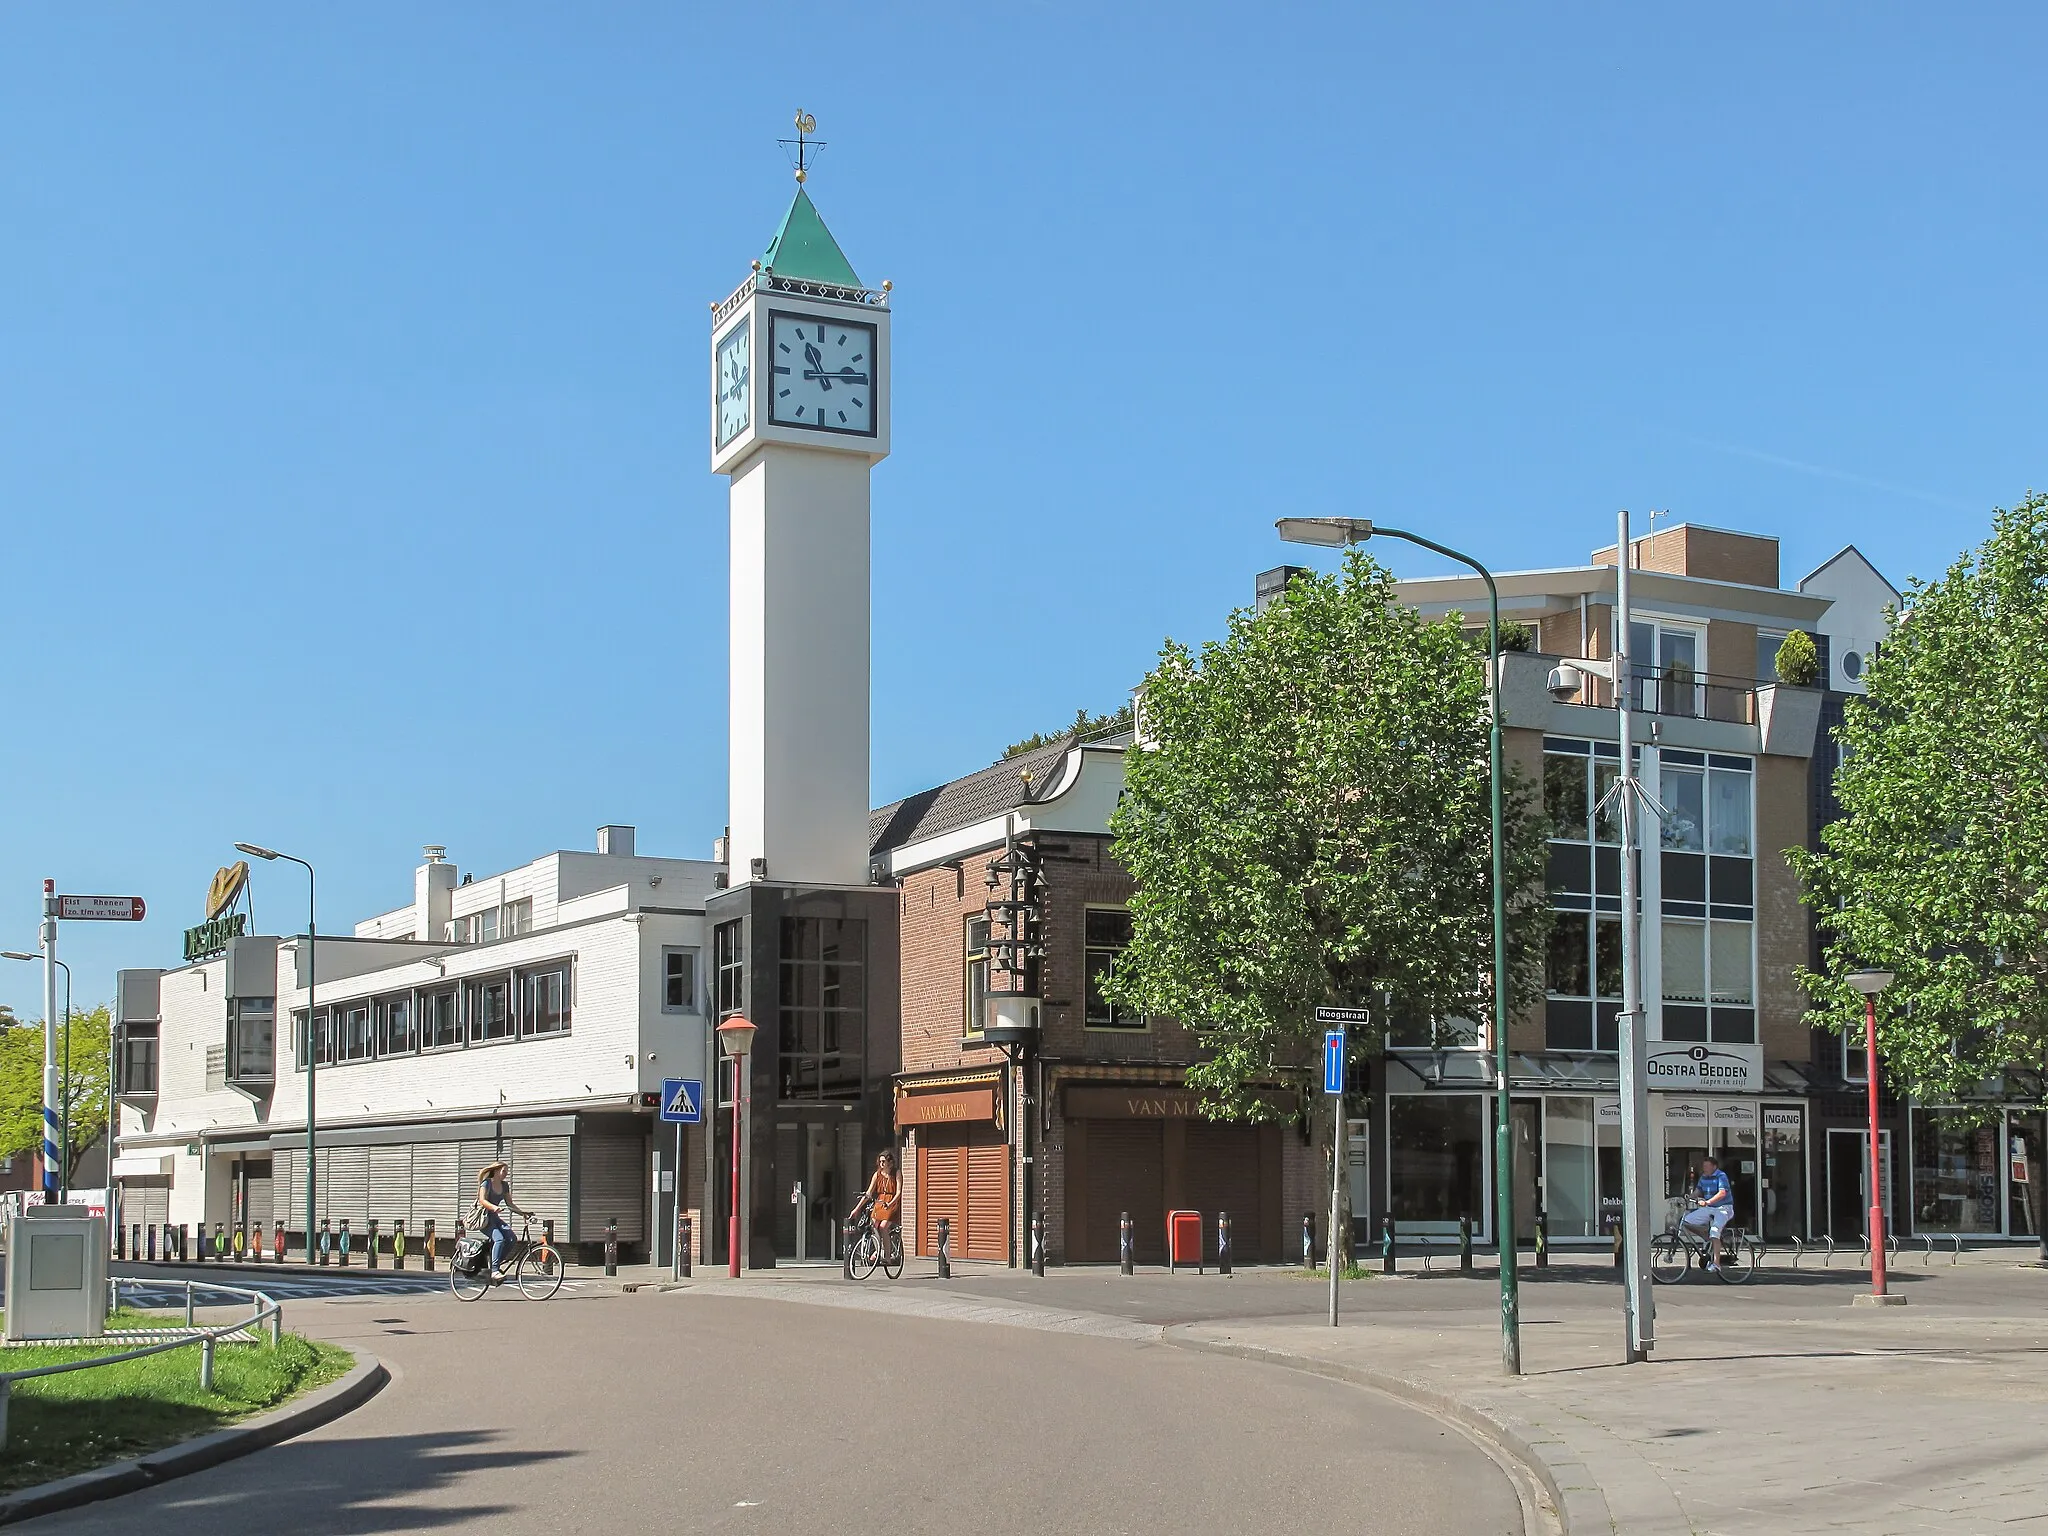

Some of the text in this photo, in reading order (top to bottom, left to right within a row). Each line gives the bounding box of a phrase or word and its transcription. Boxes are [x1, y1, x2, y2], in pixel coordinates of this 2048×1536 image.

[64, 897, 124, 907] Elst Rhenen
[65, 908, 79, 917] (zo.
[96, 909, 106, 917] vr.
[108, 909, 132, 918] 18uur)
[1319, 1009, 1365, 1020] Hoogstraat
[921, 1103, 967, 1120] VAN MANEN
[1127, 1100, 1166, 1115] VAN
[1765, 1114, 1799, 1124] INGANG
